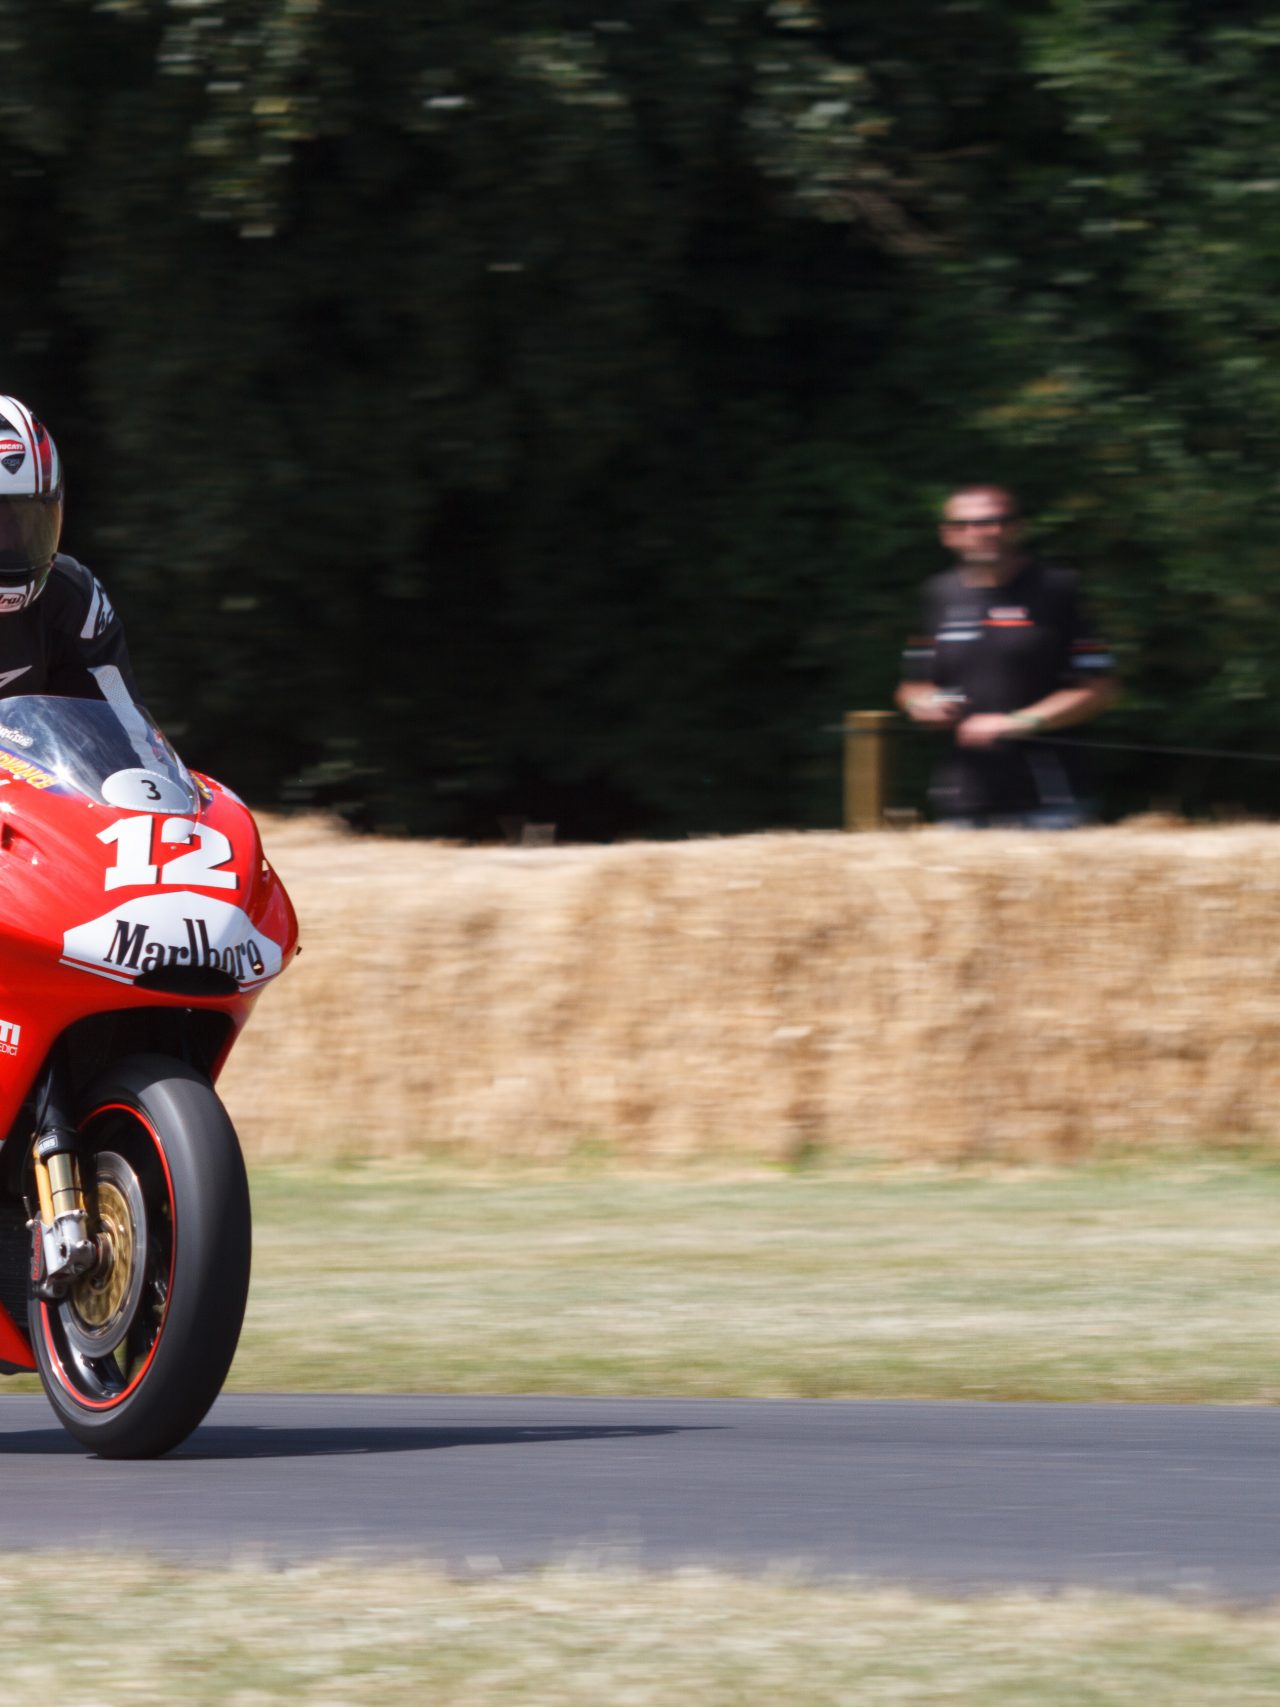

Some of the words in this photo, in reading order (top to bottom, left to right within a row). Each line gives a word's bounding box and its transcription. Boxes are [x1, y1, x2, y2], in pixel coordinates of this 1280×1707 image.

[141, 780, 162, 801] 3
[96, 815, 239, 891] 12
[103, 918, 265, 980] Marlboro
